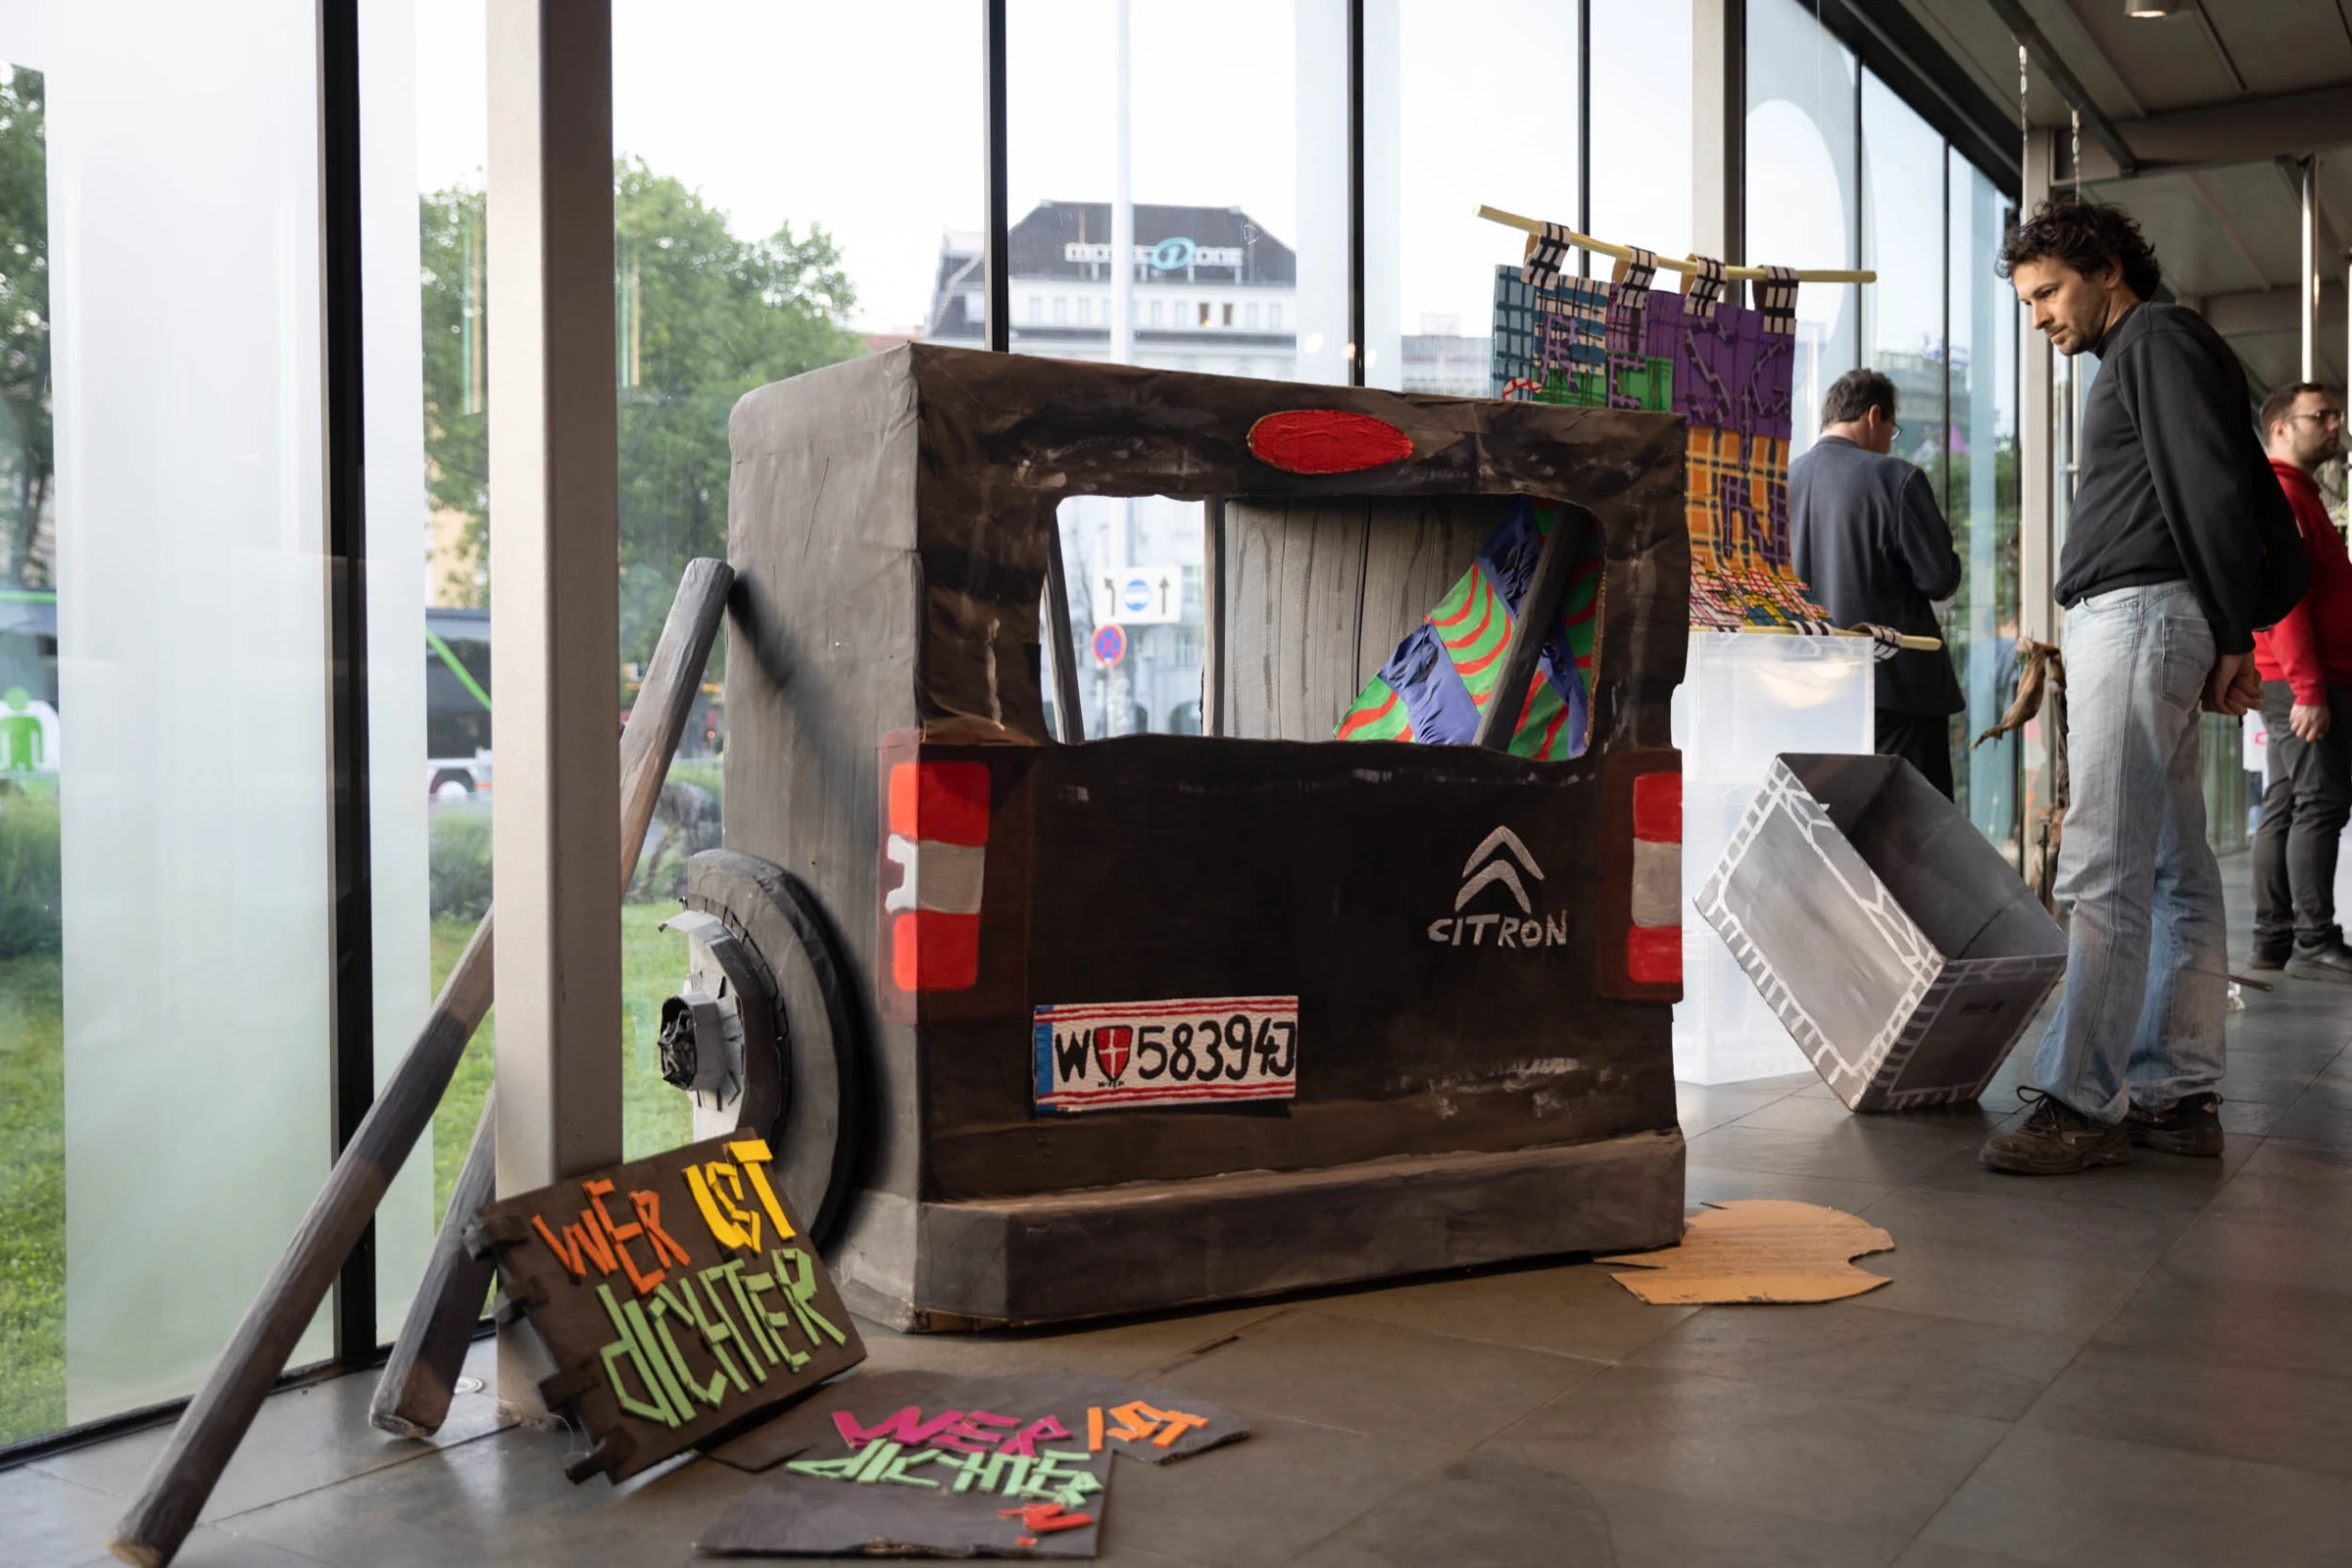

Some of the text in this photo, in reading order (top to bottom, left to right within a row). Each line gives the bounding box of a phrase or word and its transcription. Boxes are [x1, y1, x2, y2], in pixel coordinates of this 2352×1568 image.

[1428, 911, 1568, 949] CITRON
[532, 1139, 798, 1295] WER IST
[830, 1400, 1209, 1458] WER IST
